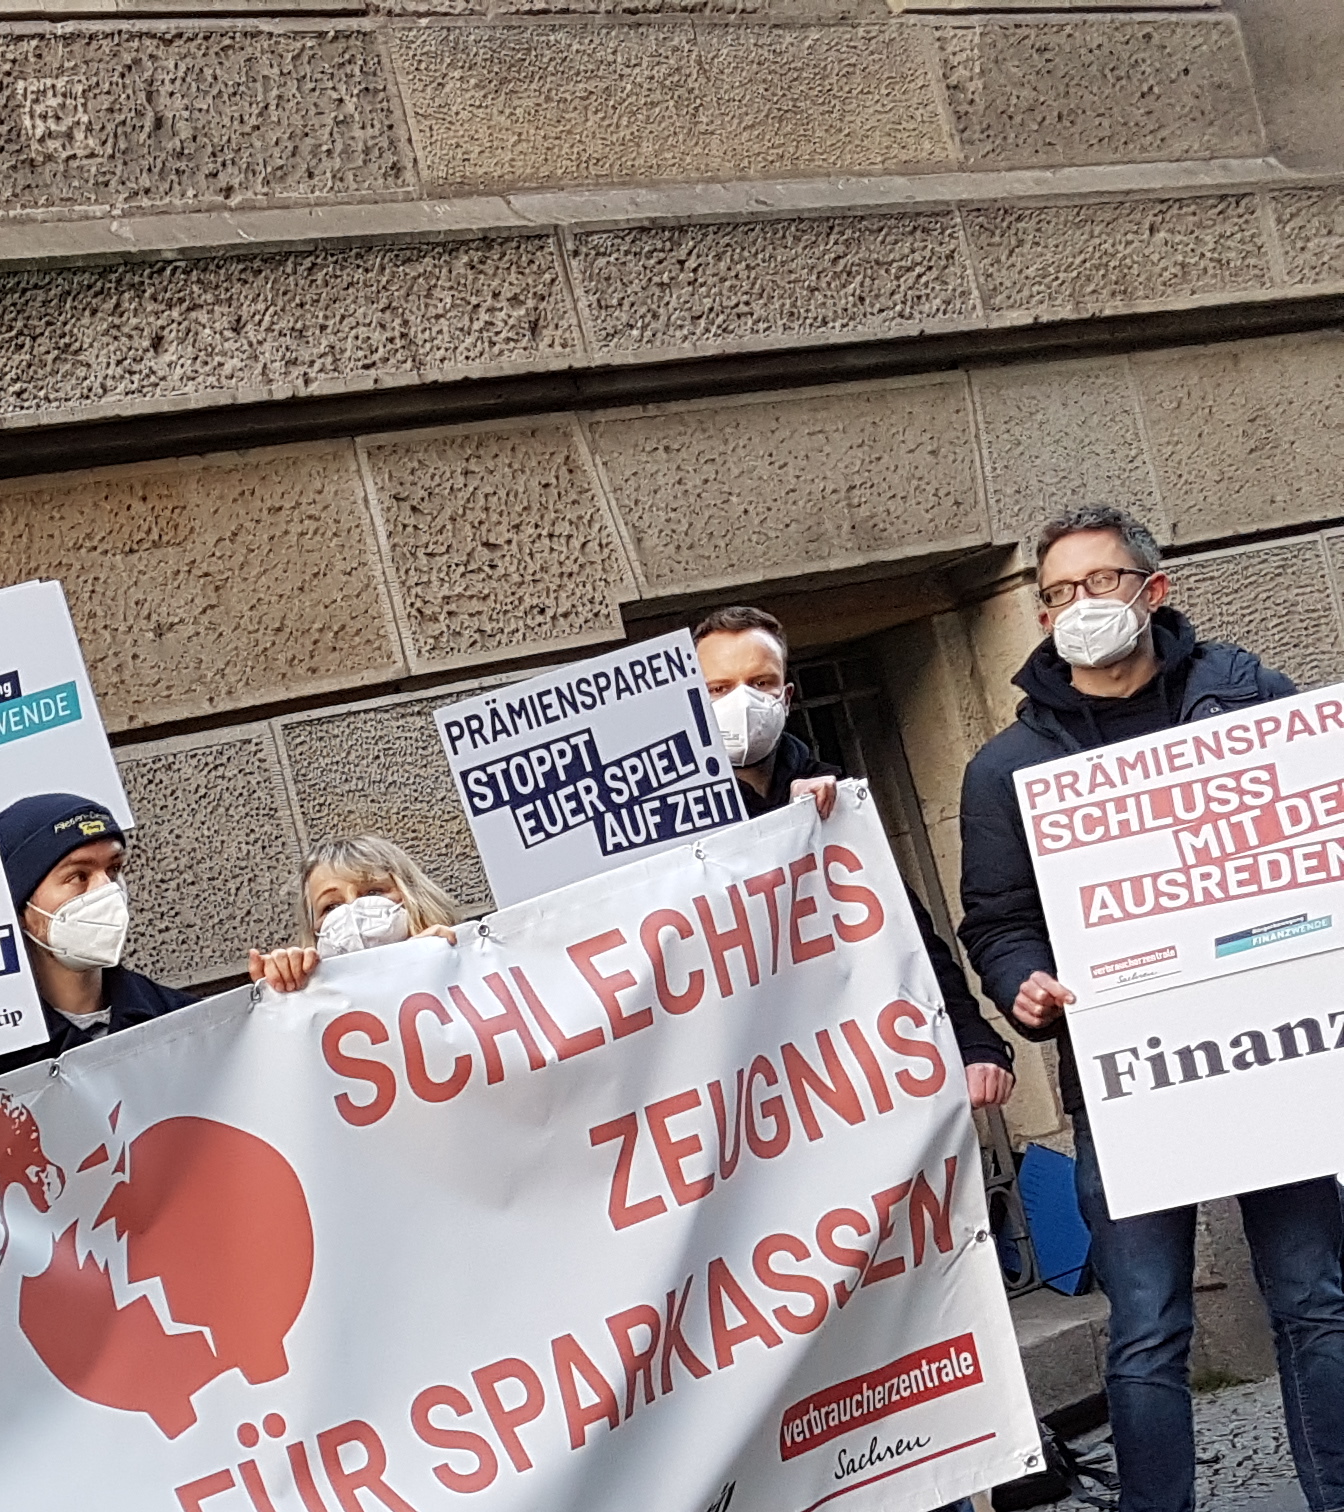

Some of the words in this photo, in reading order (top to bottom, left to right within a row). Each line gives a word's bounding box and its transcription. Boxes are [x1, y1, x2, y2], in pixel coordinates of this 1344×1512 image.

[444, 646, 697, 756] PRÄMIENSPAREN:
[466, 733, 593, 810] STOPPT
[514, 779, 601, 845] EUER
[605, 743, 695, 804] SPIEL
[606, 804, 665, 851] AUF
[674, 780, 735, 832] ZEIT
[1040, 769, 1274, 850] SCHLUSS
[1178, 809, 1262, 866] MIT
[1274, 780, 1344, 836] DE
[1252, 918, 1328, 946] FINANZWENDE
[321, 844, 884, 1127] SCHLECHTES
[589, 999, 947, 1231] ZEUGNIS
[410, 1155, 958, 1494] SPARKASSEN
[782, 1345, 973, 1448] verbraucherzentrale
[833, 1434, 931, 1481] Sachsen
